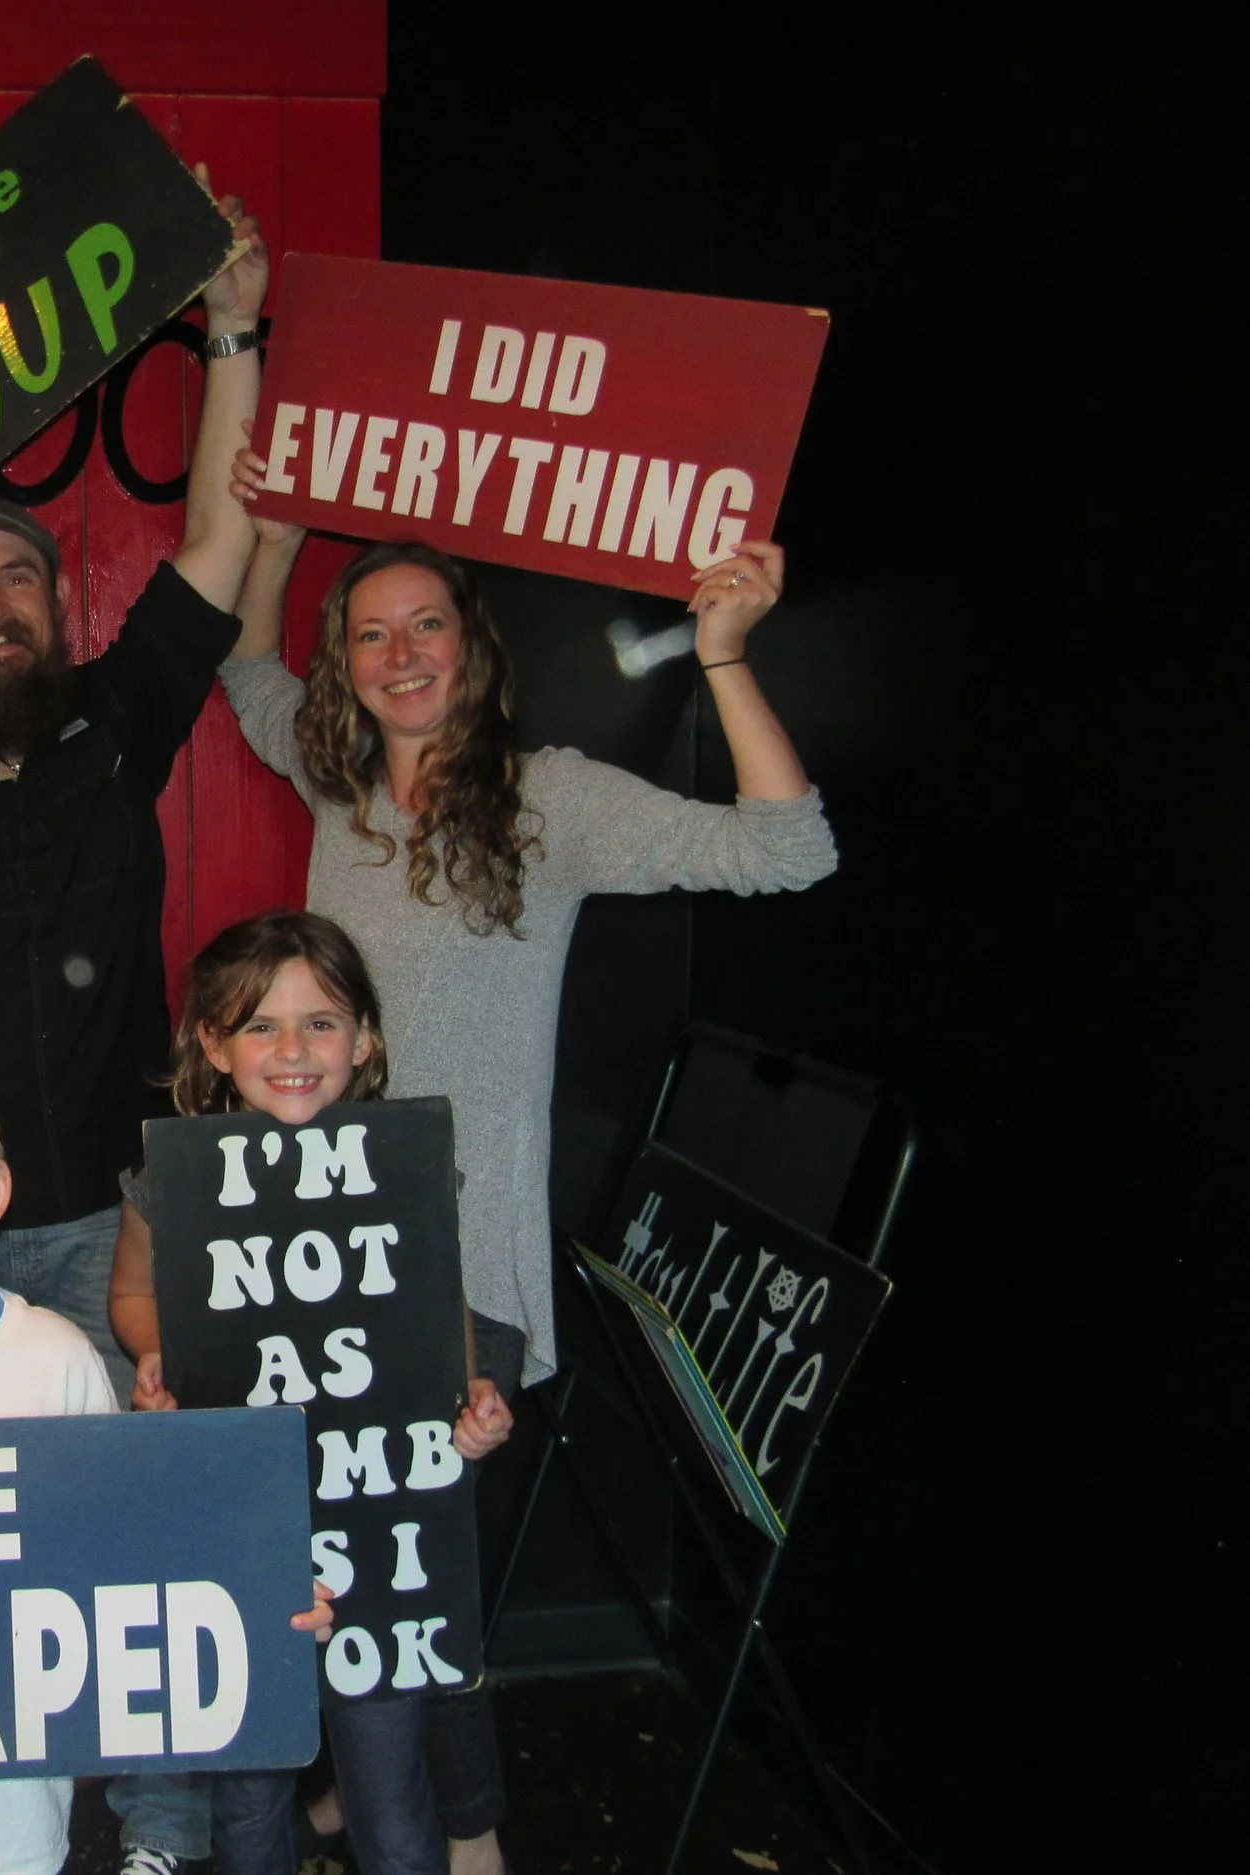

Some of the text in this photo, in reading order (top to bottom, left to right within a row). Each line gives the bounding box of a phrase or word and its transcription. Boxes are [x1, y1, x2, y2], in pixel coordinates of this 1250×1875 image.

[429, 318, 608, 417] I DID
[263, 401, 754, 571] EVERYTHING
[217, 1123, 378, 1208] I'M
[206, 1222, 400, 1312] NOT
[246, 1326, 374, 1408] AS
[316, 1419, 464, 1500] MB
[391, 1521, 429, 1592] I
[324, 1616, 465, 1697] OK
